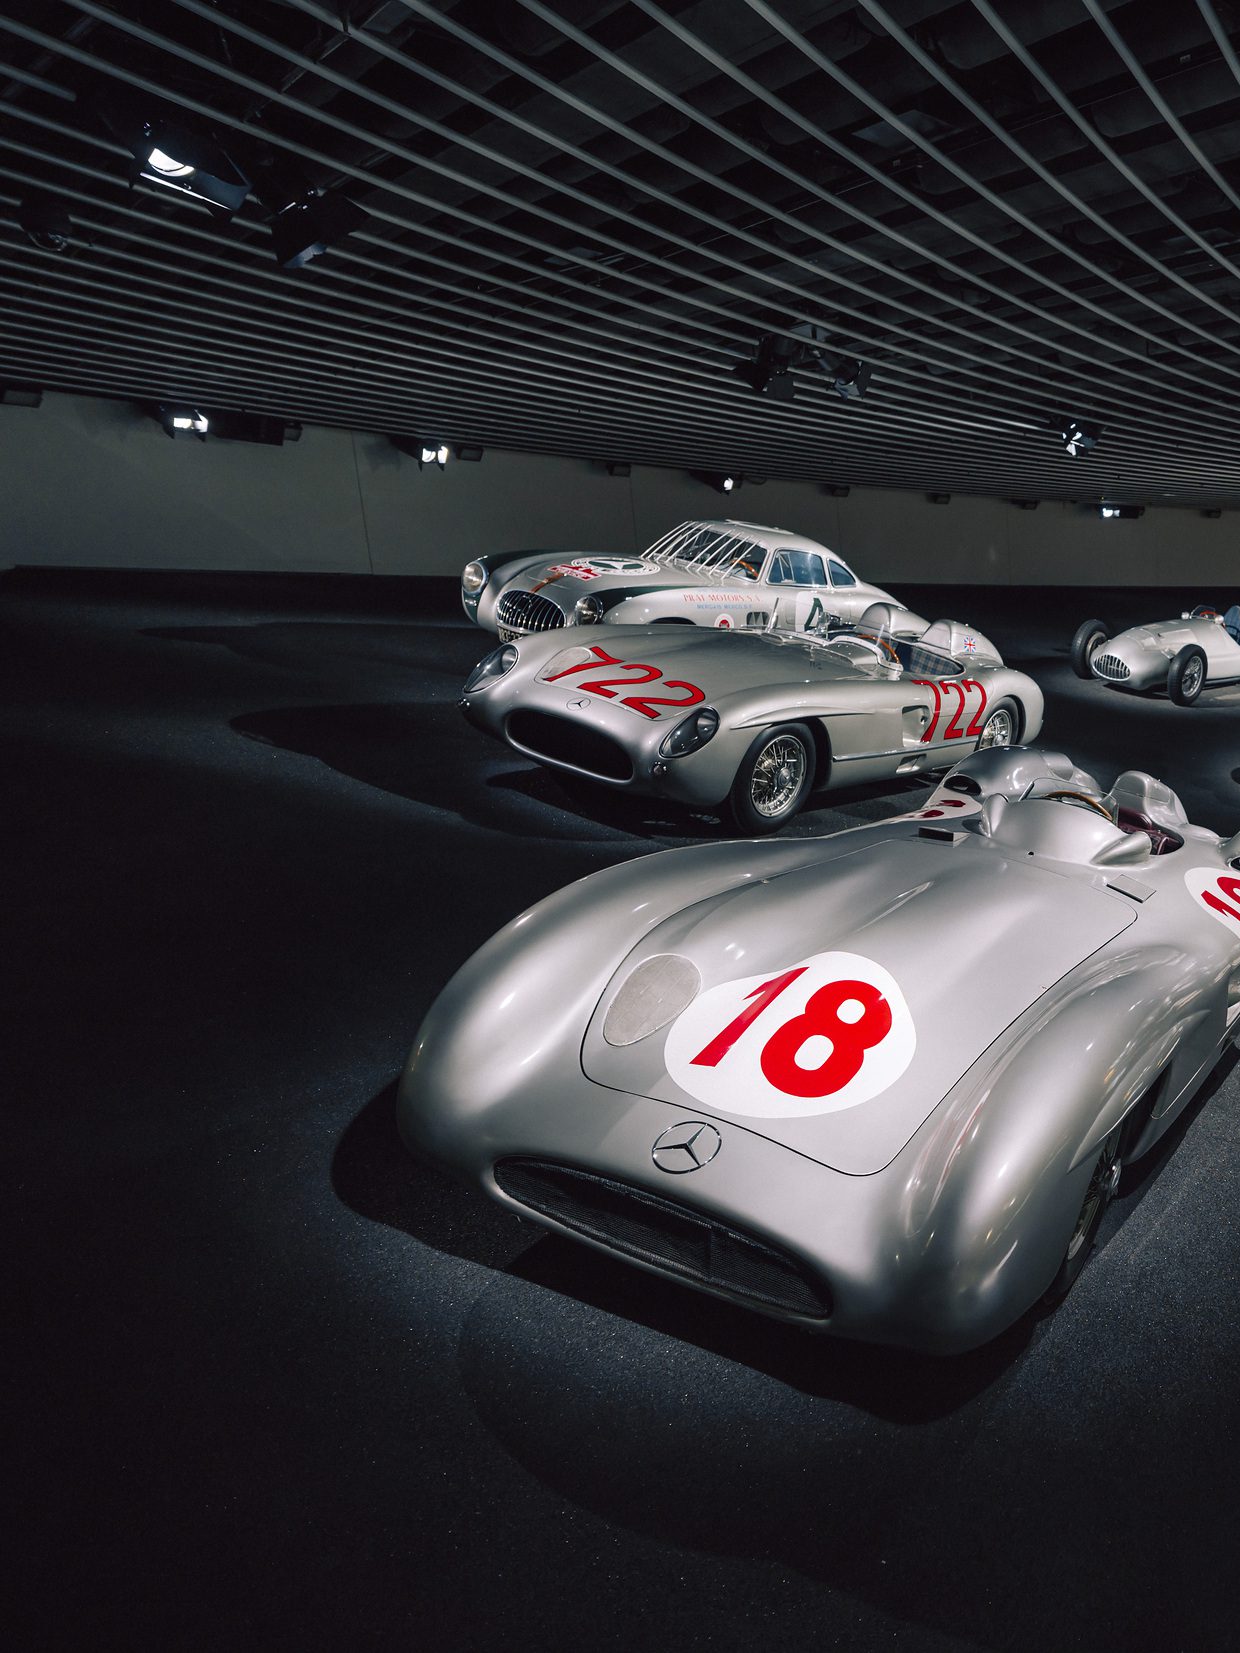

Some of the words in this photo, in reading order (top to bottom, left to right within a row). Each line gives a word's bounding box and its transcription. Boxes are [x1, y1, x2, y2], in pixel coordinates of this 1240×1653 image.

[708, 594, 745, 602] MOTORS
[542, 645, 706, 720] 722
[912, 679, 988, 743] 722
[688, 965, 893, 1098] 18
